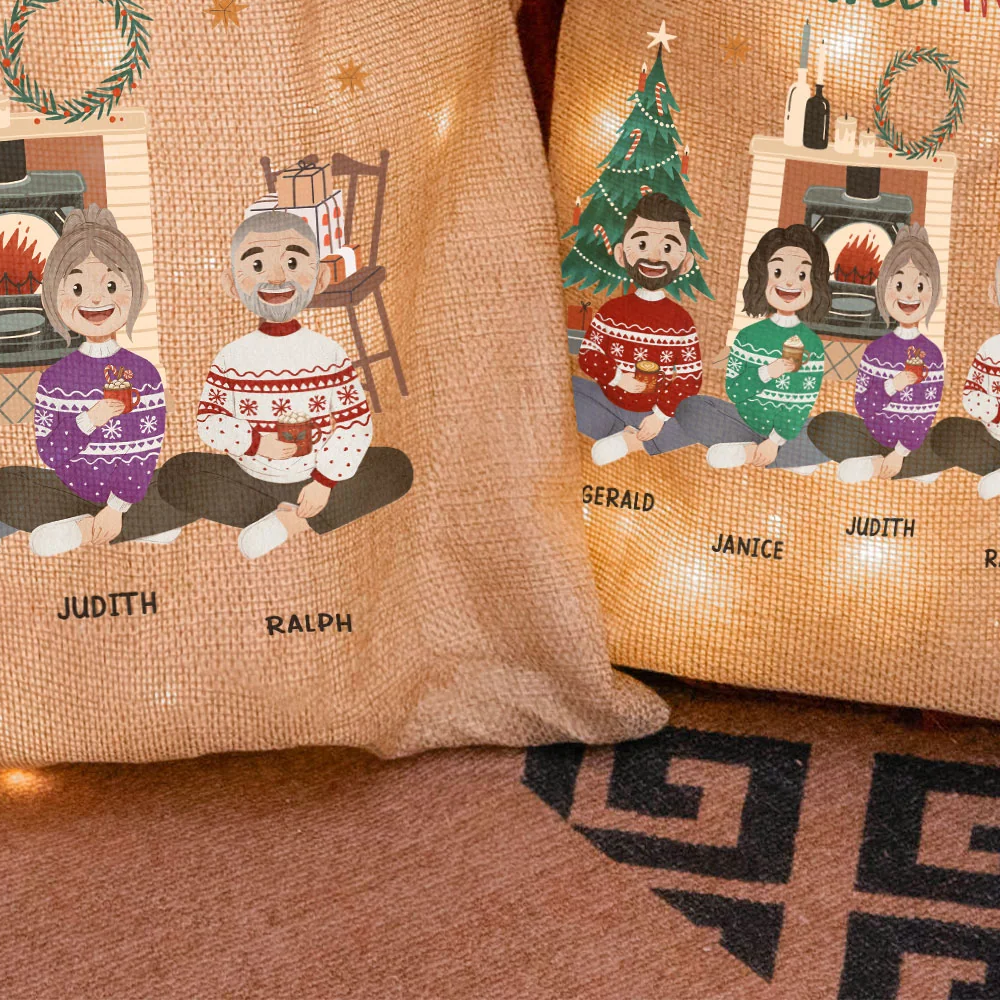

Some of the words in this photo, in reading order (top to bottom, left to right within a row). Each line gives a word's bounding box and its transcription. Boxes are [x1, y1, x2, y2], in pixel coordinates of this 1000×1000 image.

[582, 484, 655, 512] GERALD
[846, 516, 915, 538] JUDITH
[711, 533, 784, 561] JANICE
[57, 591, 157, 620] JUDITH
[265, 613, 352, 636] RALPH
